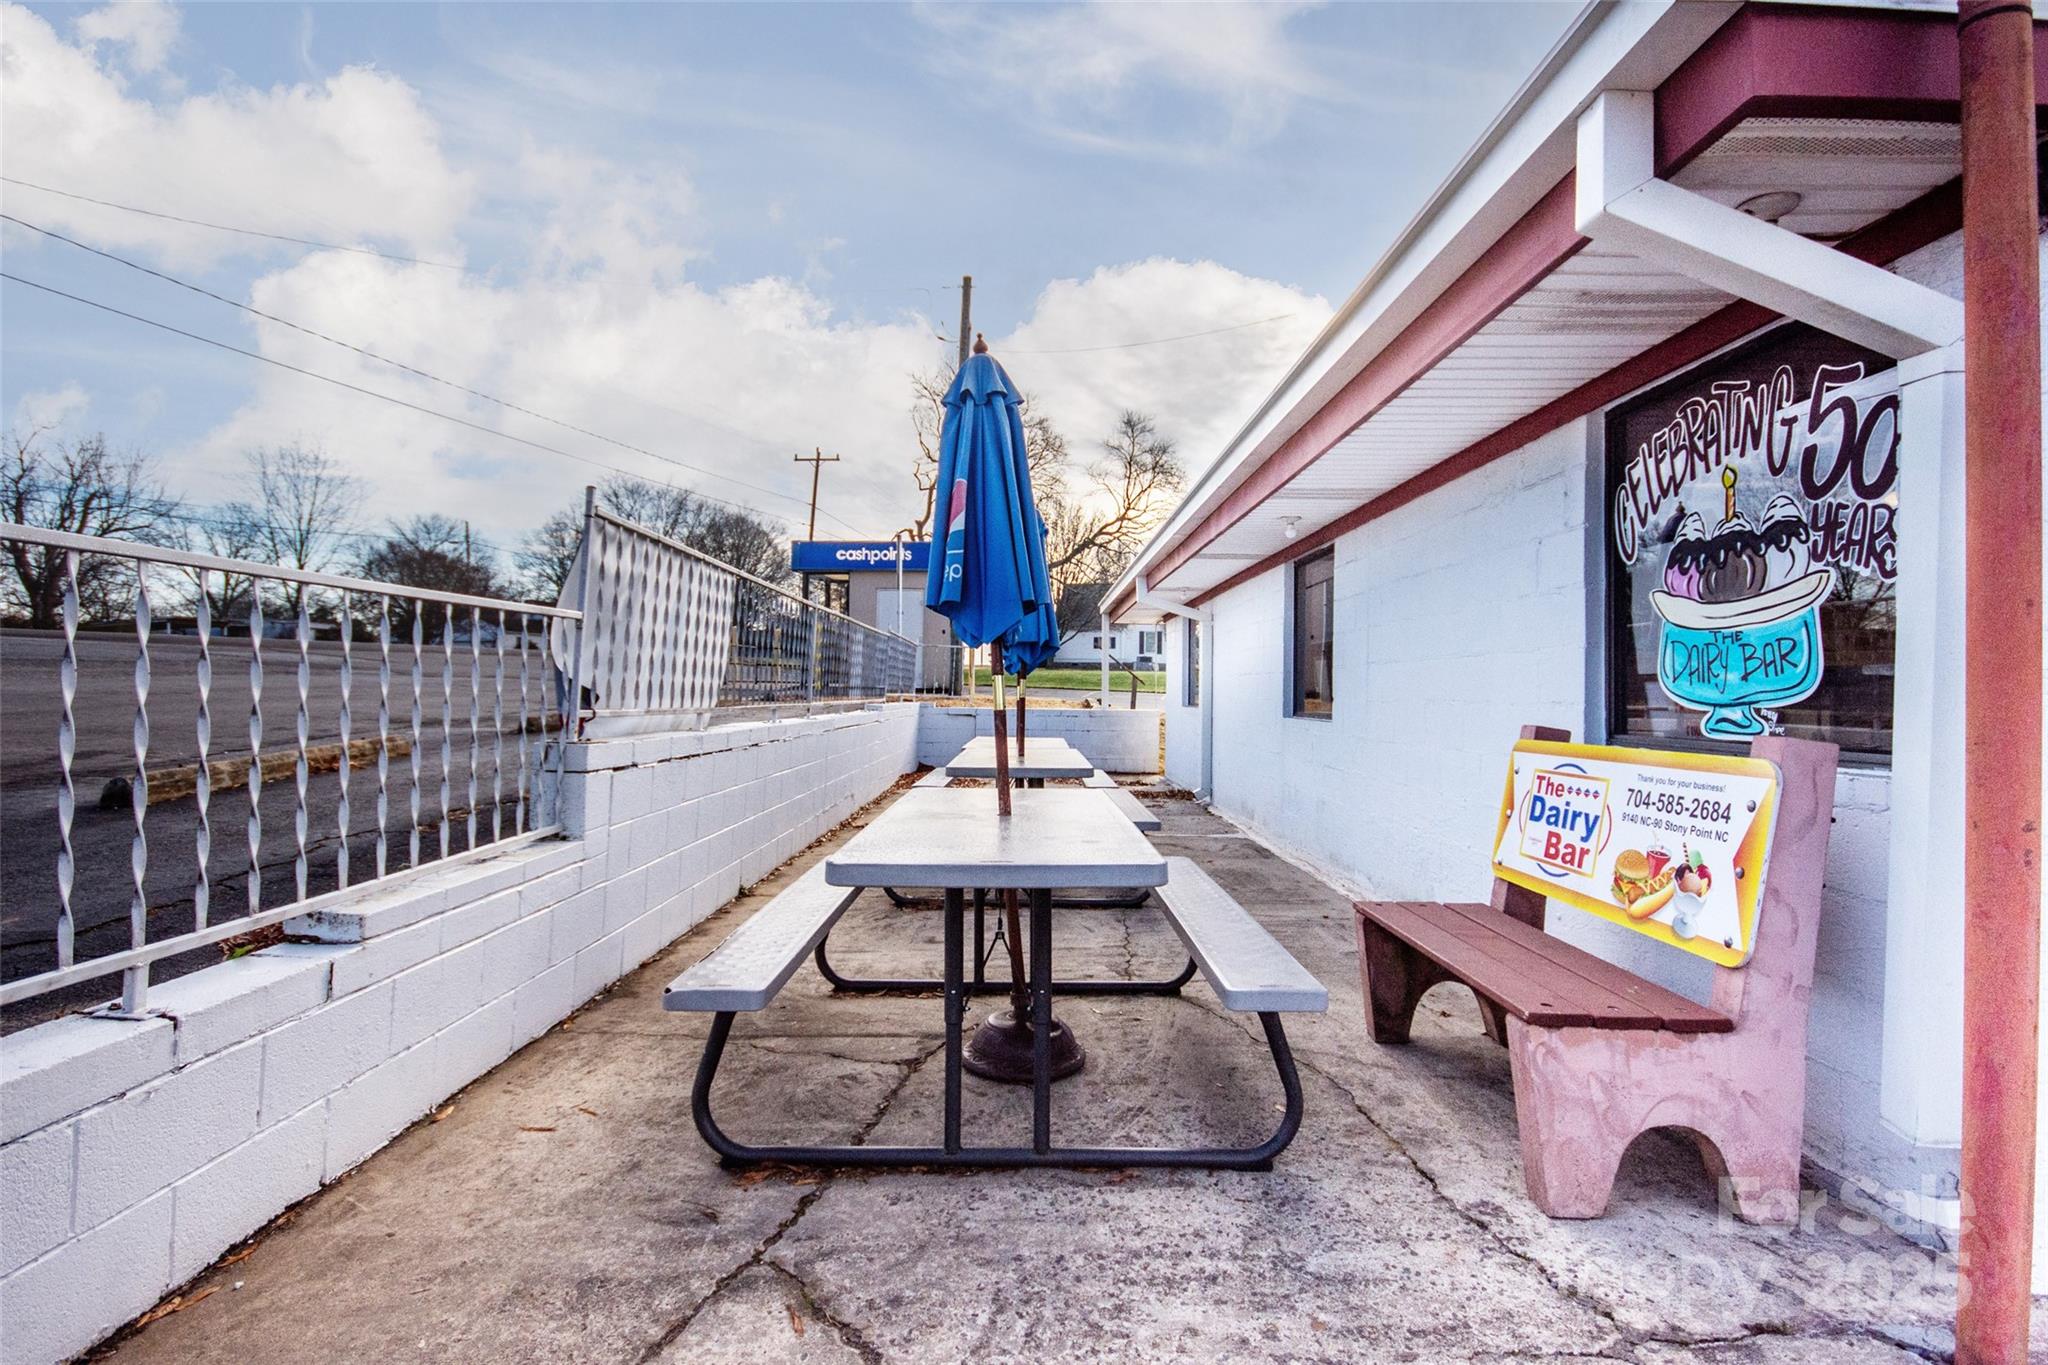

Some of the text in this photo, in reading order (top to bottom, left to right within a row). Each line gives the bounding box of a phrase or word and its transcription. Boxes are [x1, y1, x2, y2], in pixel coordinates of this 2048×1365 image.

[1616, 362, 1900, 564] CELEBRATING 50
[1709, 630, 1744, 645] THE
[1670, 637, 1798, 695] DAIRY BAR
[1536, 774, 1565, 798] The
[1637, 773, 1654, 783] Thank
[1655, 778, 1667, 786] you
[1667, 777, 1676, 786] for
[1677, 780, 1692, 789] your
[1529, 794, 1600, 843] Dairy
[1626, 788, 1732, 824] 704-585-2684
[1622, 812, 1729, 843] 9140 NC-90 Stony Point NC
[1544, 830, 1591, 869] Bar
